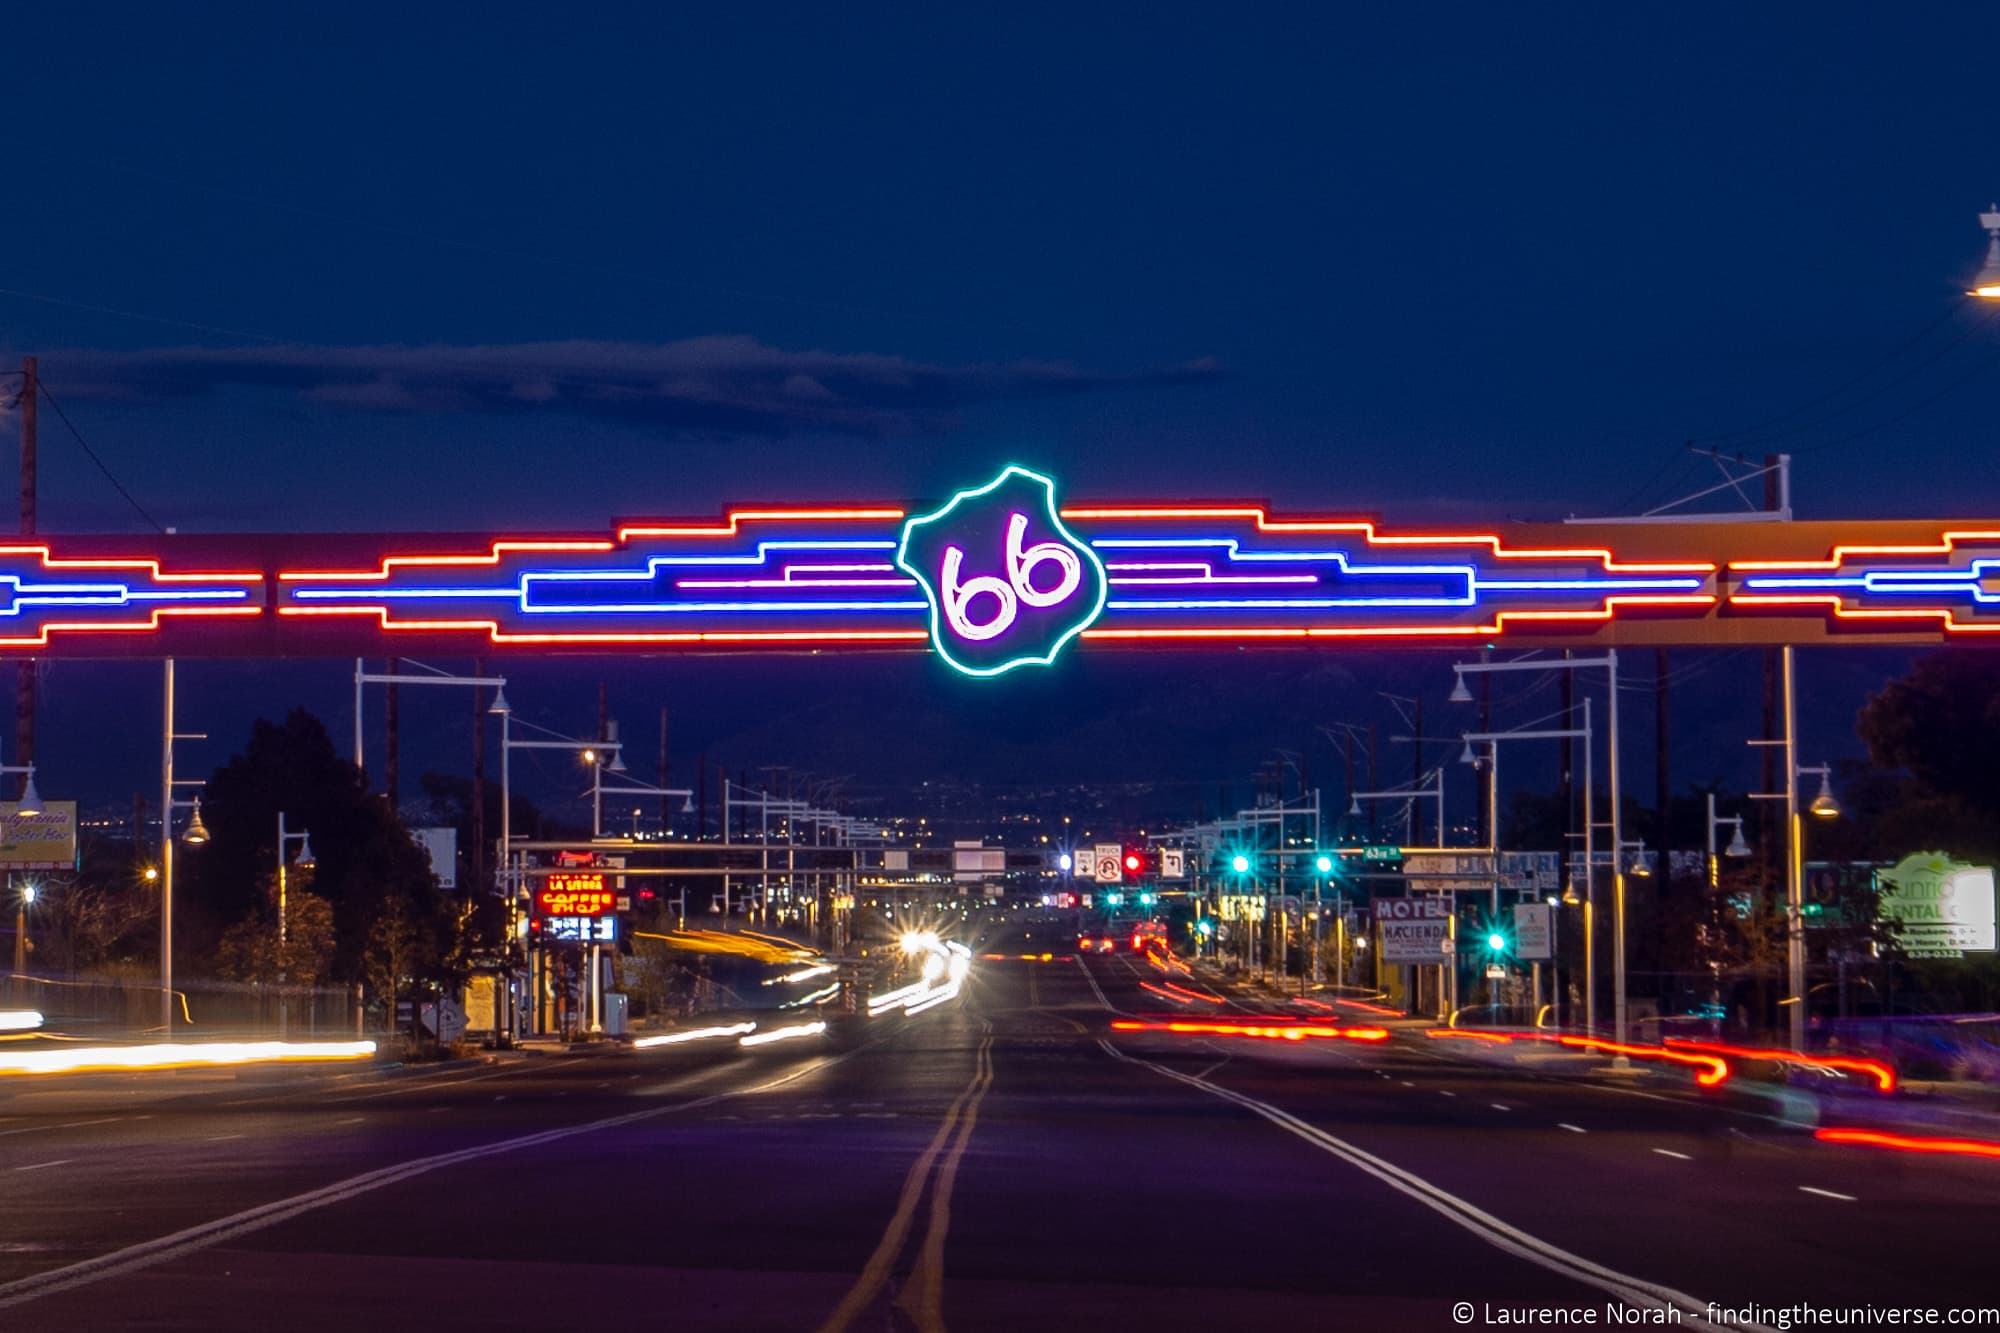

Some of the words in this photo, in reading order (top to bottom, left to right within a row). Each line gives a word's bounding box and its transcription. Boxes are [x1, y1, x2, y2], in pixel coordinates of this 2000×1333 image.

[941, 512, 1081, 640] 66
[550, 880, 563, 890] LA
[543, 893, 611, 904] COFFEE
[552, 903, 600, 913] SHOP
[1376, 902, 1448, 919] MOTEL
[1384, 925, 1449, 938] HACIENDA
